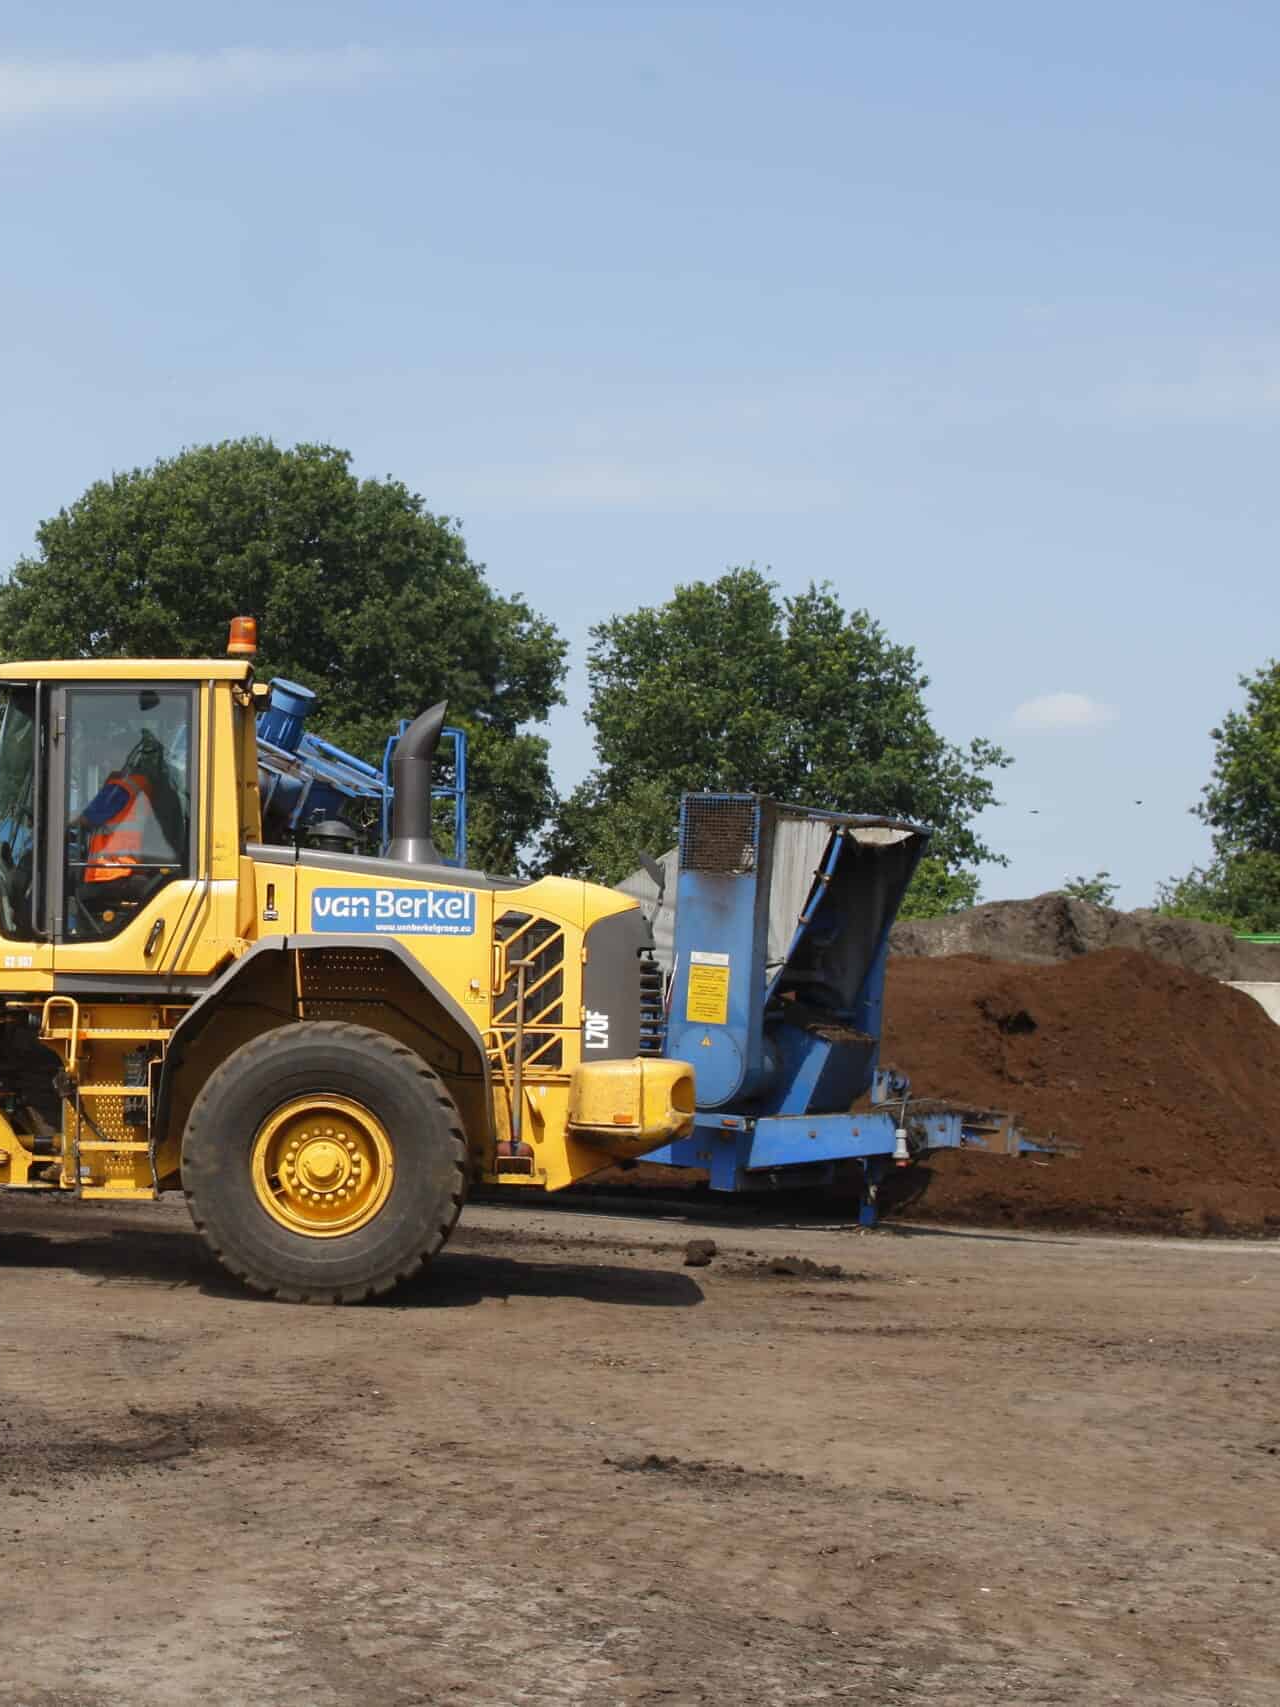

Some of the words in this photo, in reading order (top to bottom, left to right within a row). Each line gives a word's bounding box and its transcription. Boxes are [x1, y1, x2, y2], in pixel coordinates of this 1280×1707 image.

[314, 896, 369, 917] van
[375, 890, 470, 919] Berkel
[585, 1010, 609, 1048] L70F
